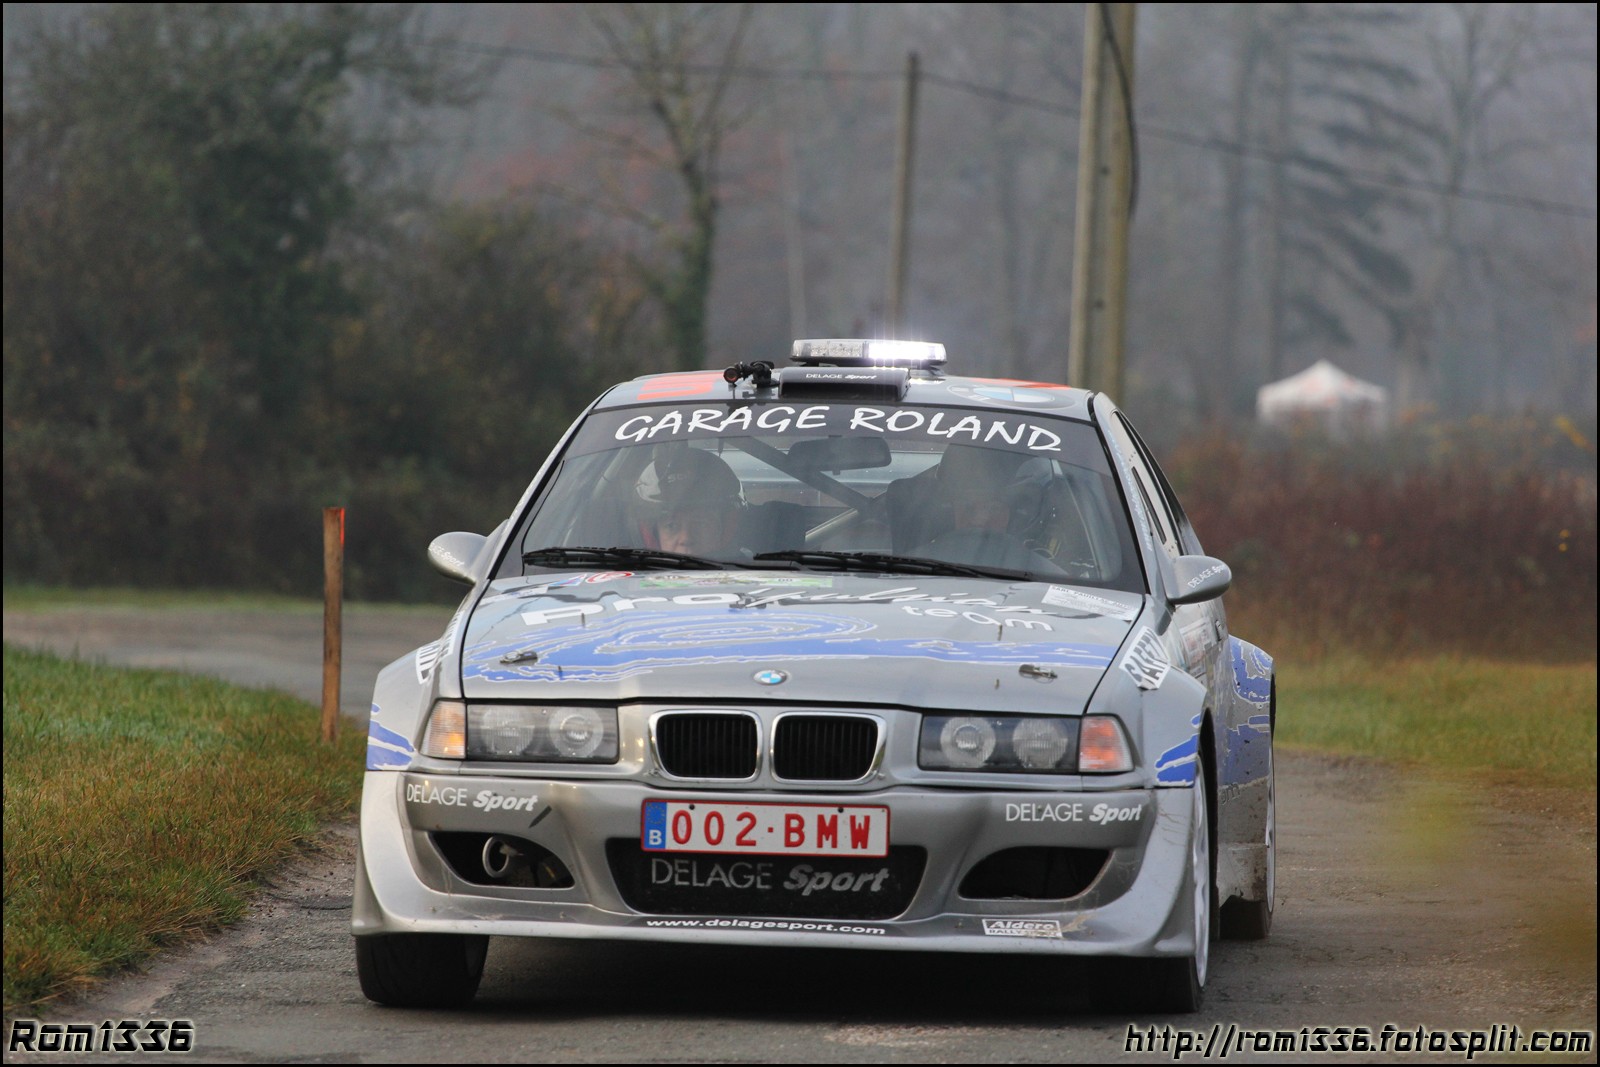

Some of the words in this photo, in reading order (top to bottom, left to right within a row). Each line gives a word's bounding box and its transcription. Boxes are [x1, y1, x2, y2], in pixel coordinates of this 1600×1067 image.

[614, 406, 830, 442] GARAGE
[850, 408, 1061, 451] ROLAND
[902, 604, 1053, 632] team
[407, 784, 467, 807] DELAGE
[473, 790, 539, 812] Sport
[1006, 803, 1083, 822] DELAGE
[1089, 803, 1142, 825] Sport
[649, 830, 662, 845] B
[652, 858, 774, 889] DELAGE
[783, 863, 889, 896] Sport
[647, 918, 886, 935] www.delagesport.com
[990, 921, 1054, 930] Aldero
